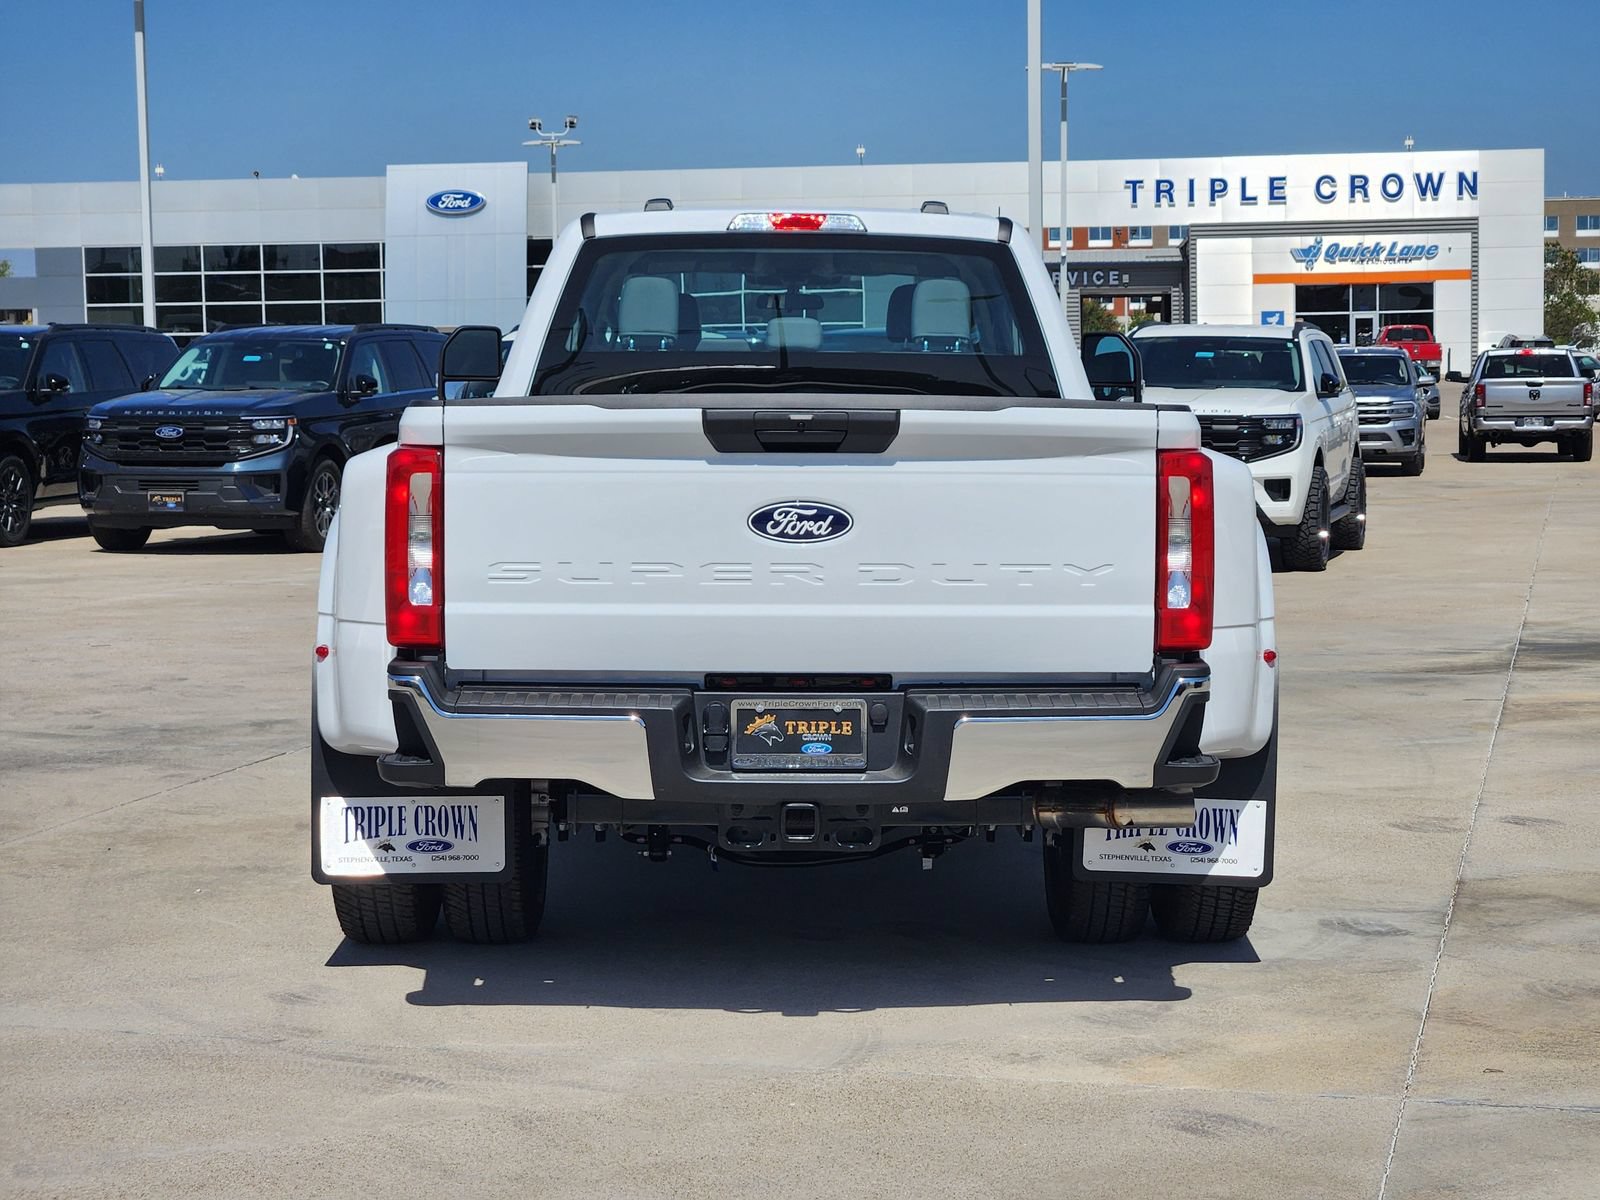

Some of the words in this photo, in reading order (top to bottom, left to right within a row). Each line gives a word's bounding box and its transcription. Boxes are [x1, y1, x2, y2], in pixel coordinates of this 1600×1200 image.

[1125, 176, 1287, 207] TRIPLE
[1314, 171, 1478, 203] CROWN
[438, 193, 472, 209] Ford
[1324, 242, 1386, 263] Quick
[1386, 241, 1439, 260] Lane
[1052, 271, 1119, 285] RVICE
[766, 508, 834, 536] Ford
[488, 562, 824, 585] SUPER
[858, 562, 1115, 586] DUTY
[785, 721, 852, 735] TRIPLE
[807, 745, 825, 753] Ford
[342, 804, 407, 844] TRIPLE
[414, 805, 478, 843] CROWN
[416, 841, 444, 851] Ford
[1176, 842, 1204, 853] Ford
[391, 855, 413, 863] TEXAS
[448, 854, 479, 862] 968-7000
[1099, 853, 1150, 862] STEPHENVILLE,
[1190, 856, 1206, 864] (254)
